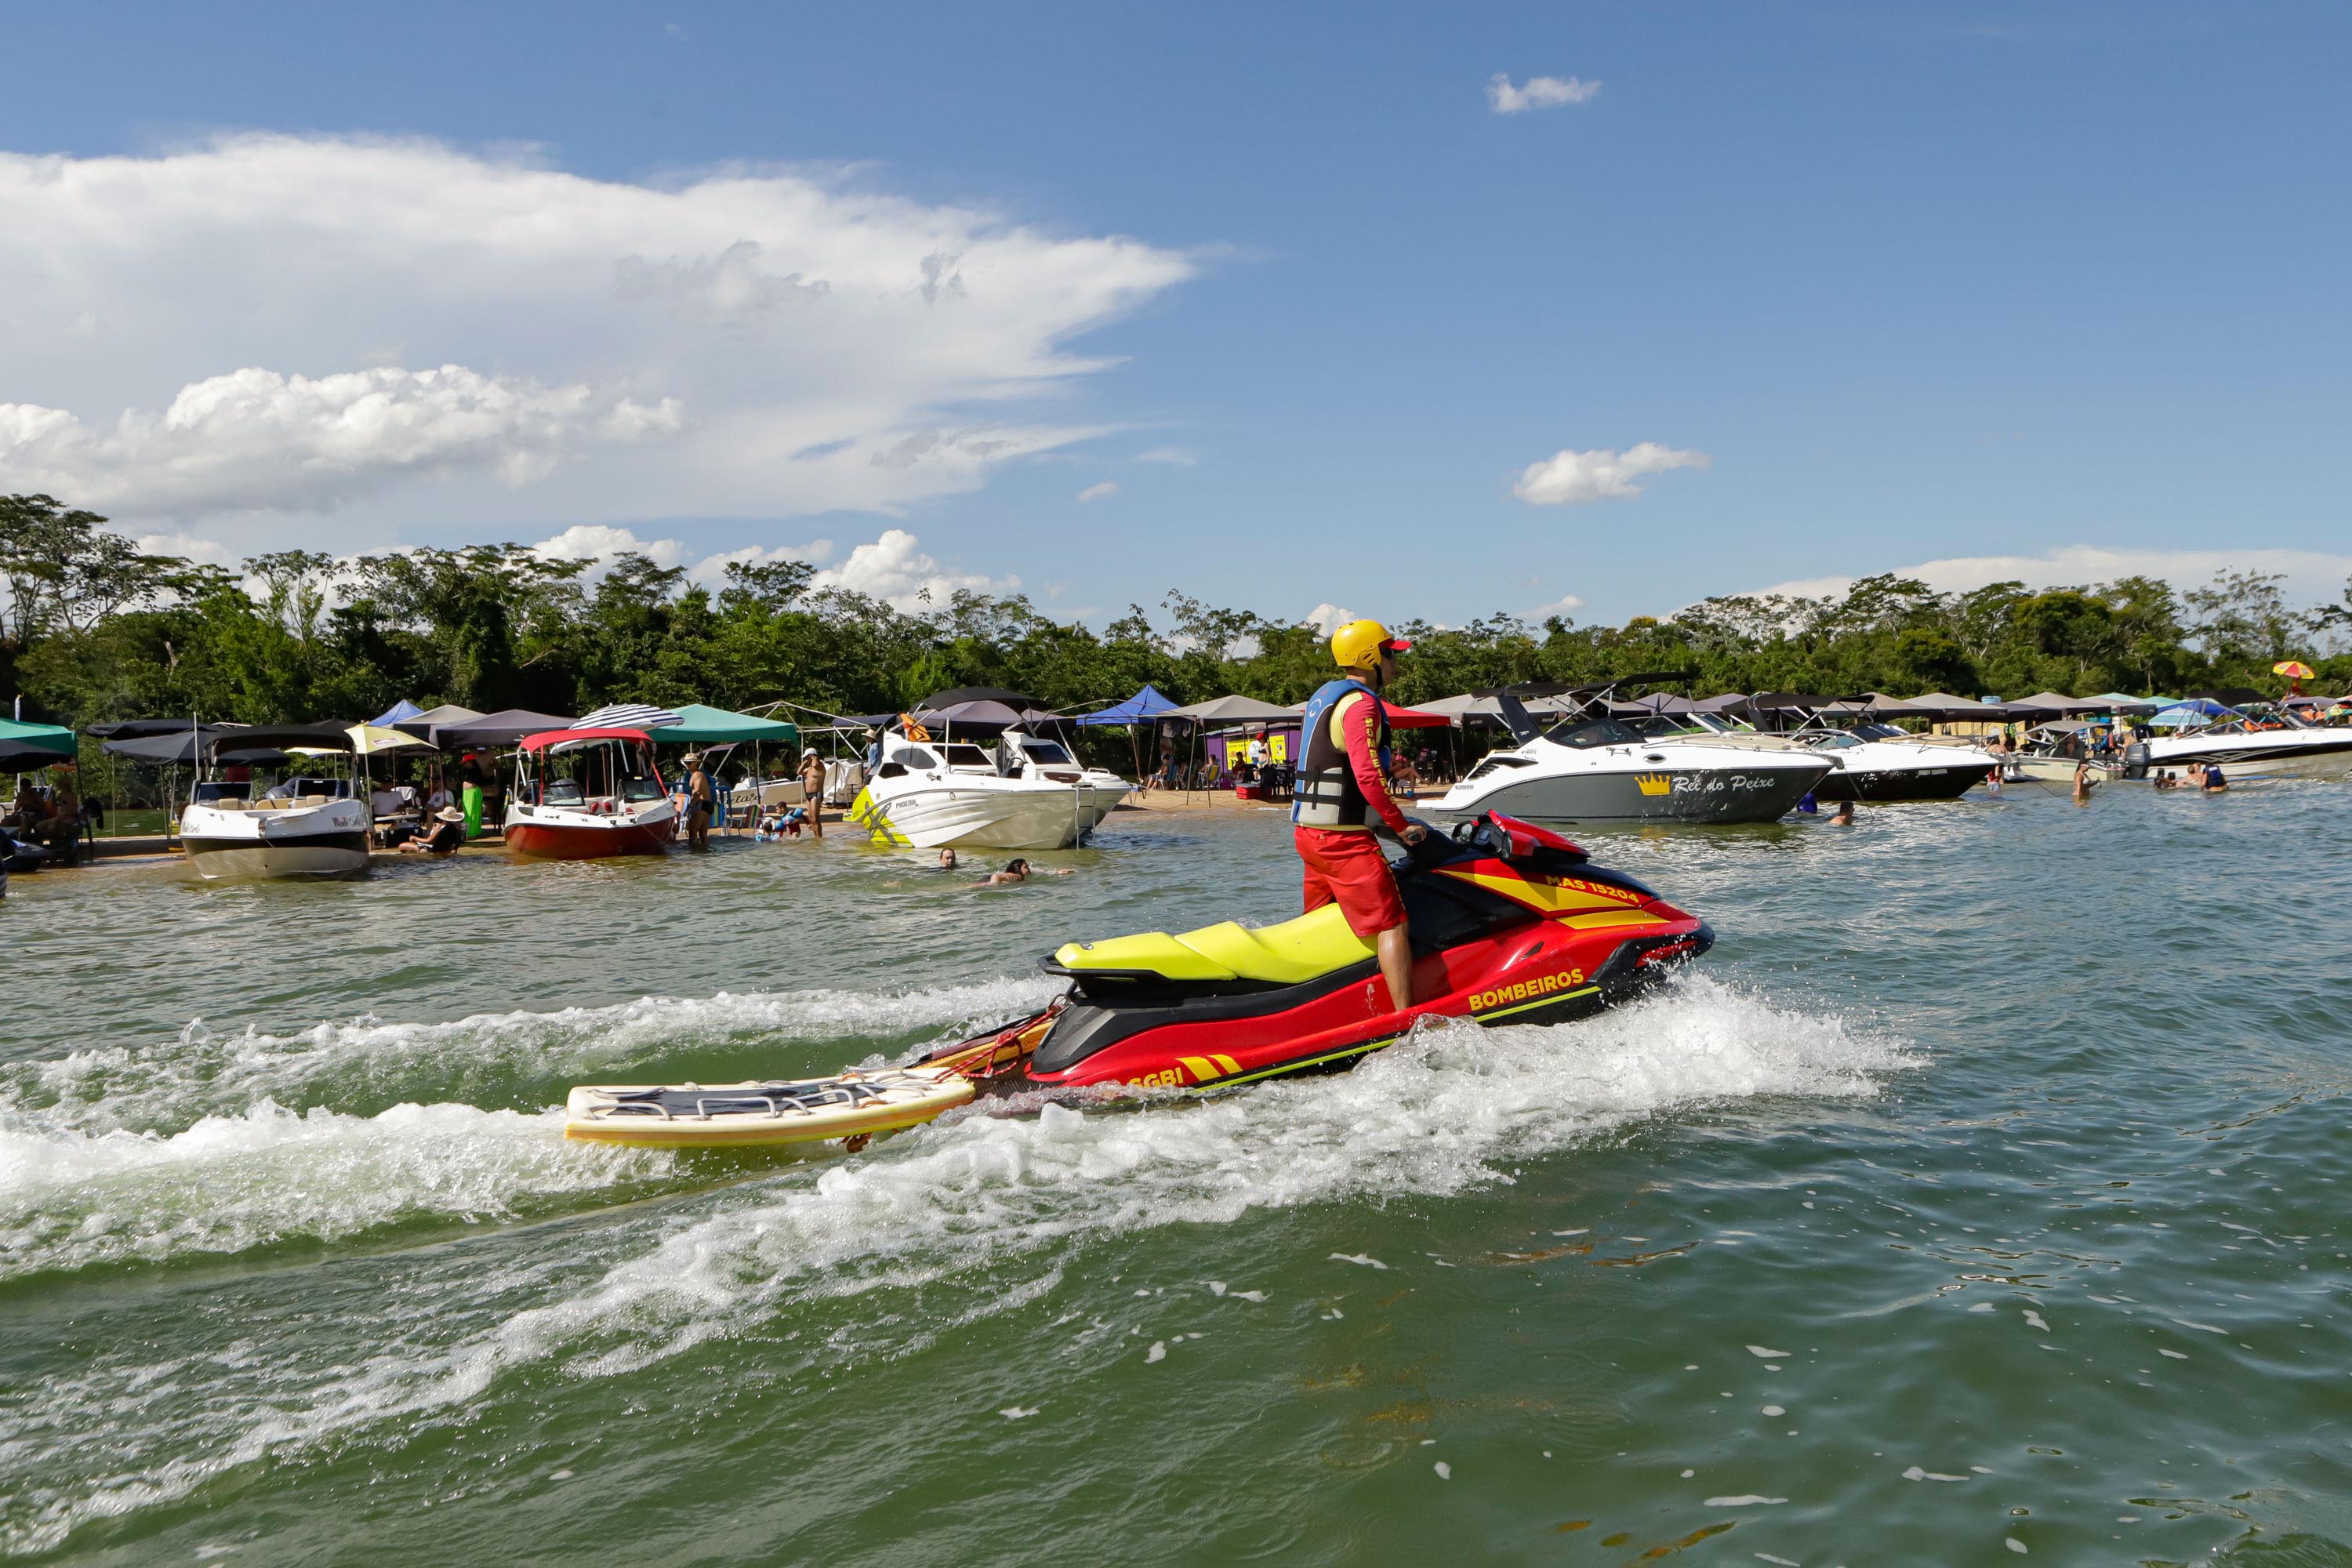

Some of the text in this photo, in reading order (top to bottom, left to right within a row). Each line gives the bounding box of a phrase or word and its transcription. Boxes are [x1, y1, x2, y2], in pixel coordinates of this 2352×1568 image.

[1672, 775, 1774, 793] Rei do Peixe
[895, 800, 916, 809] PHOENIX
[1544, 875, 1639, 903] MAS 15204
[1468, 967, 1584, 1011] BOMBEIROS
